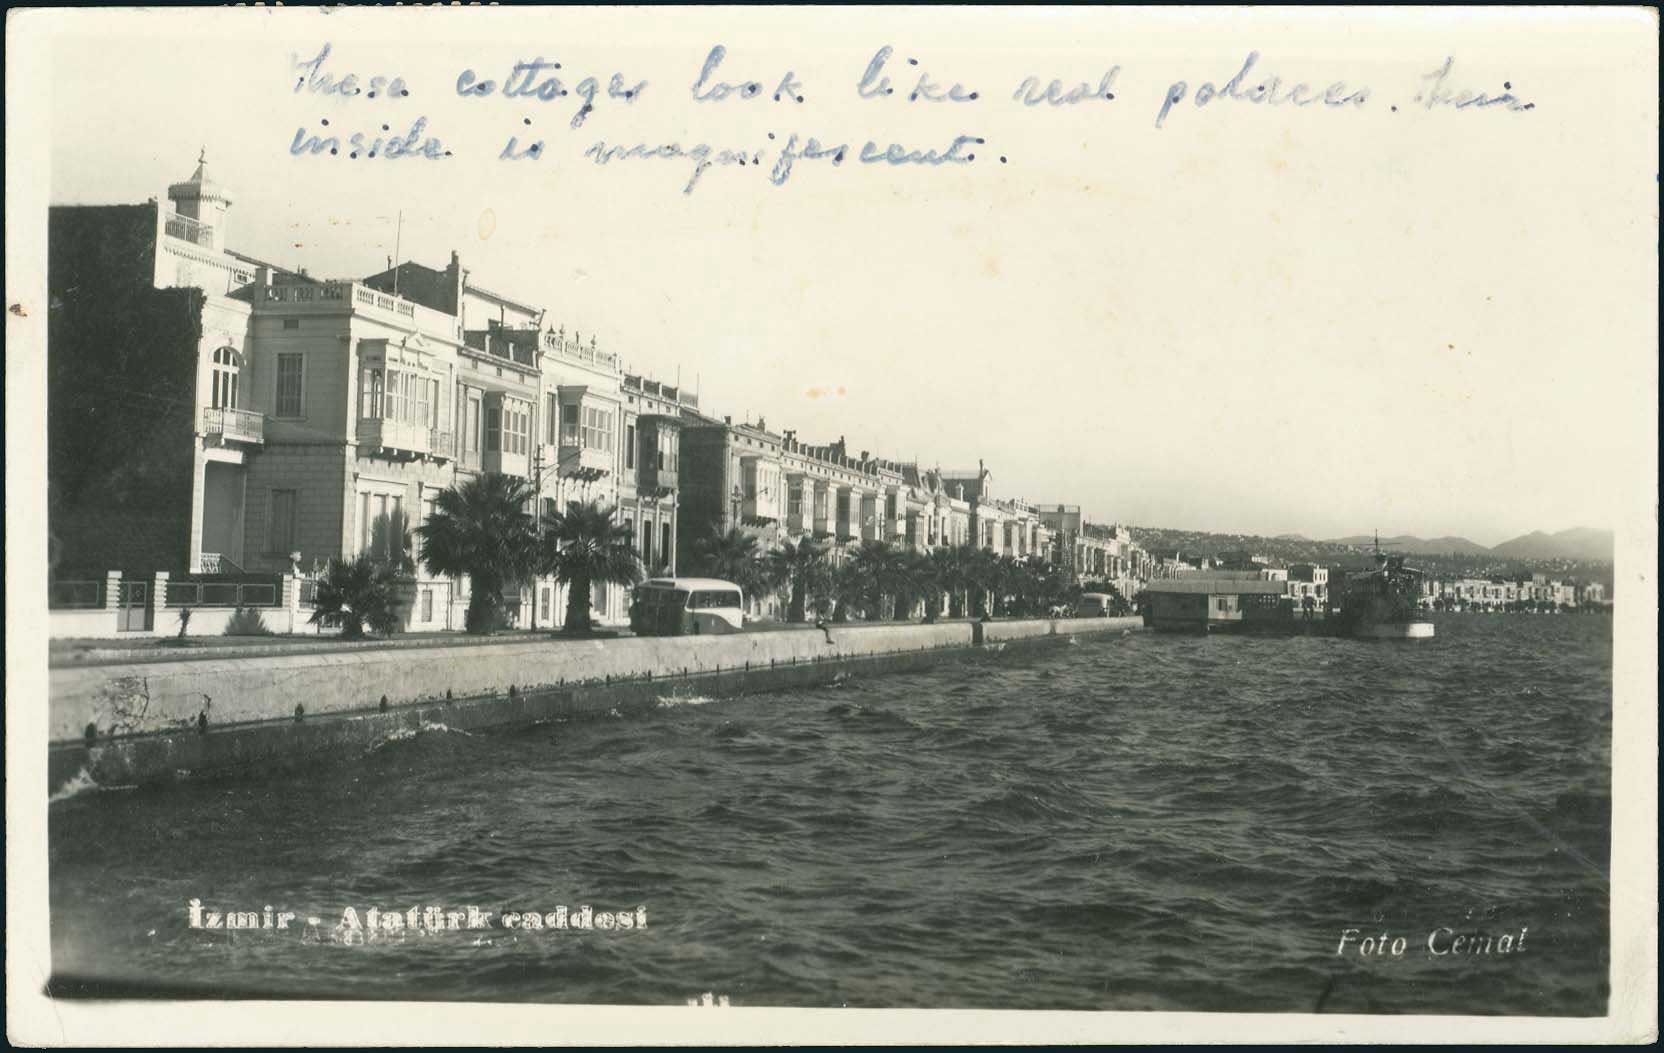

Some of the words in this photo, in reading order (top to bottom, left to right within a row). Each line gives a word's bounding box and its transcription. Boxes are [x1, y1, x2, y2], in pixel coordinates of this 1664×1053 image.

[692, 44, 804, 103] look
[857, 45, 979, 102] like
[1012, 64, 1121, 106] real
[289, 115, 453, 160] inside
[499, 118, 545, 161] is
